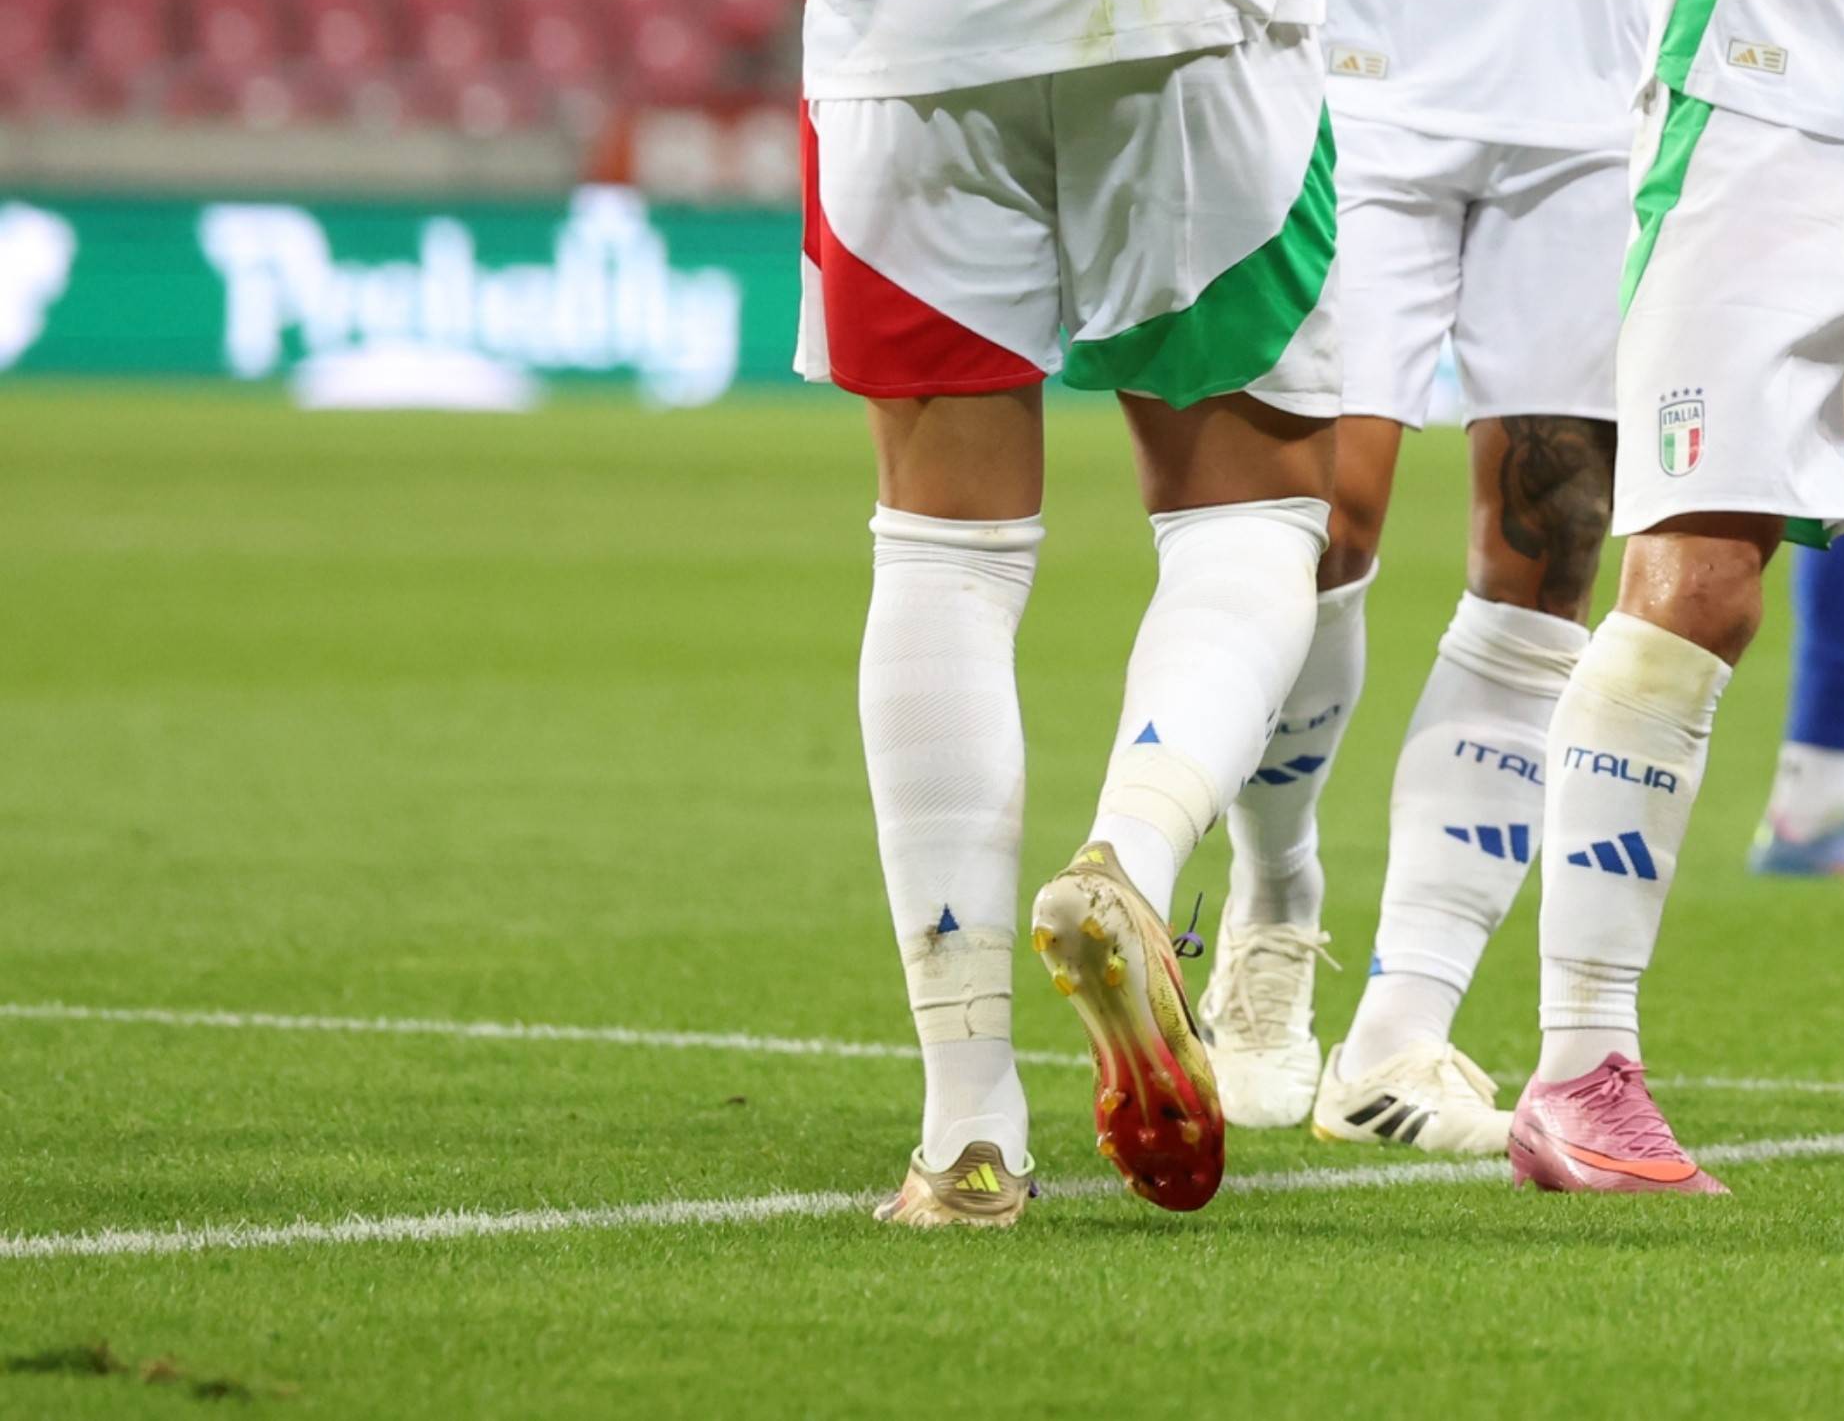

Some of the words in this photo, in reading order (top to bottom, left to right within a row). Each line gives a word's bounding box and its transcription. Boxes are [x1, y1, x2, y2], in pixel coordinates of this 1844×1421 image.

[1662, 406, 1700, 426] ITALIA
[1456, 740, 1545, 786] ITAL
[1564, 746, 1677, 794] ITALIA
